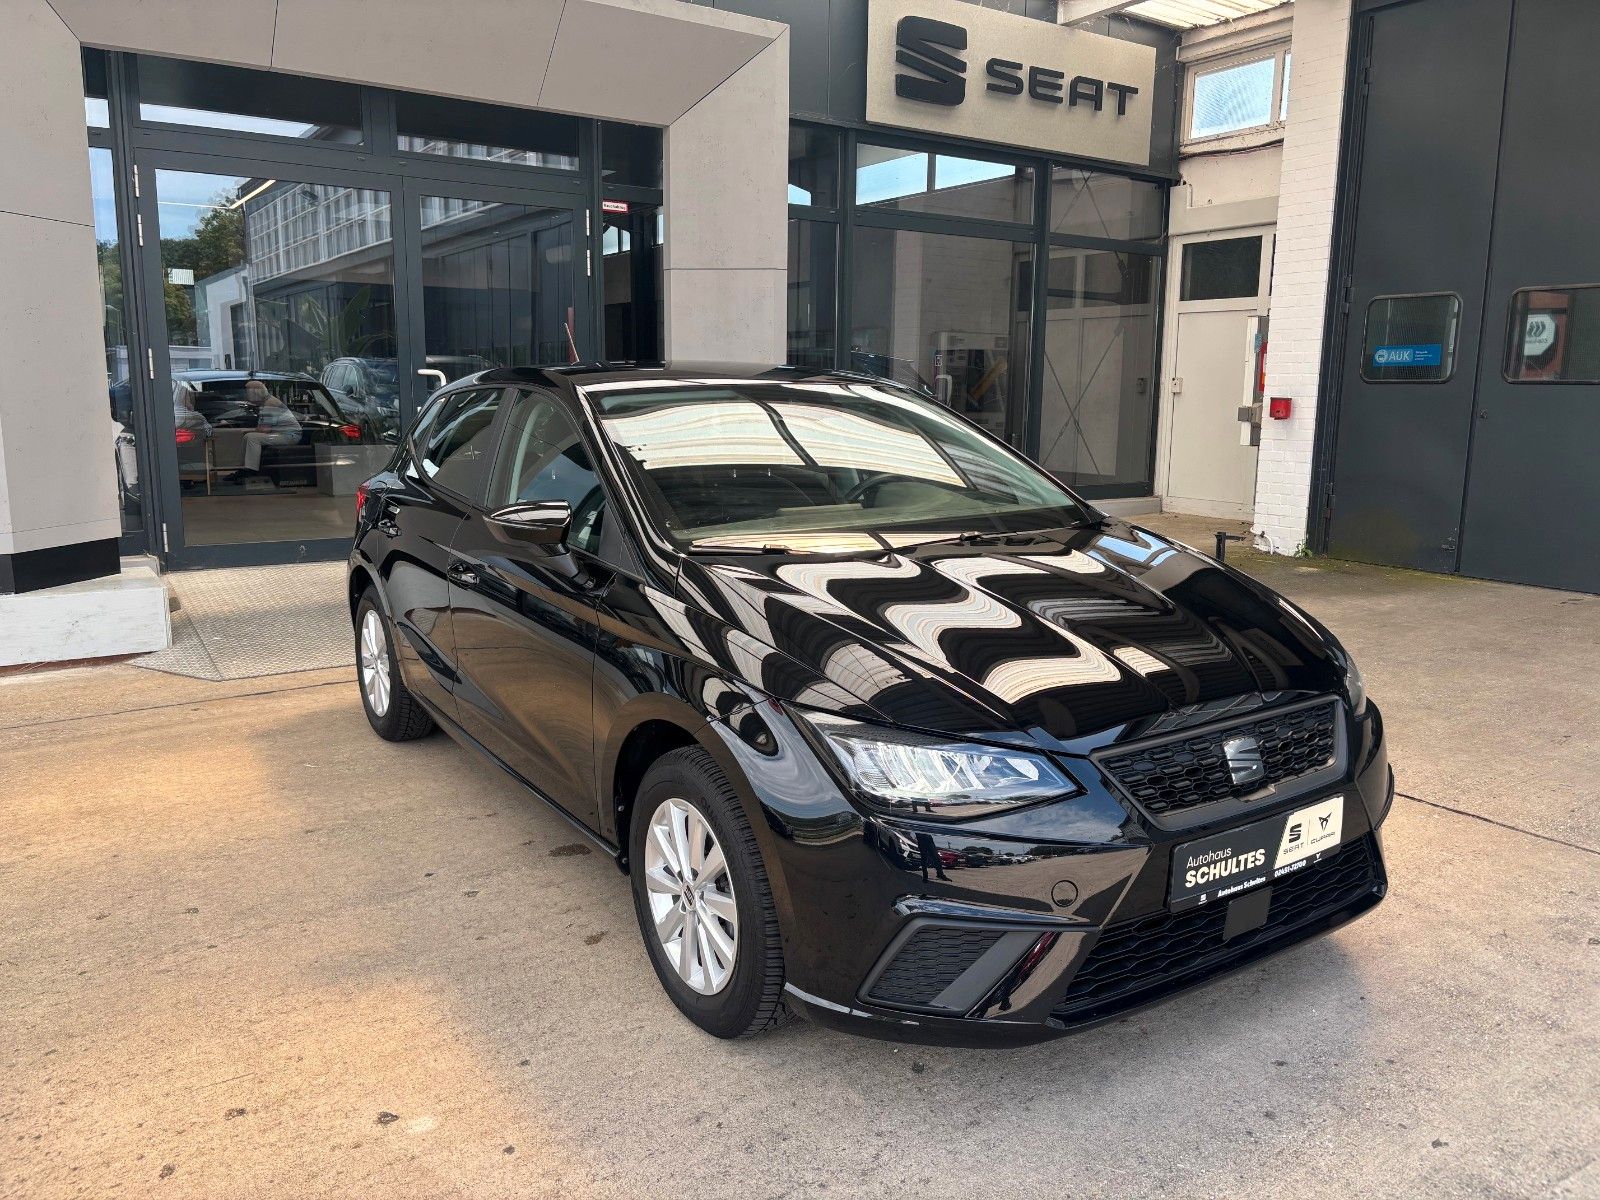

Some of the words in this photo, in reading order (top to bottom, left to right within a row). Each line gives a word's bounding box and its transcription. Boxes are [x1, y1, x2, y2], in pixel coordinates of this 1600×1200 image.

[985, 57, 1139, 116] SEAT
[1186, 847, 1232, 869] Autohaus
[1282, 842, 1305, 855] SEAT
[1185, 848, 1266, 888] SCHULTES
[1217, 884, 1243, 898] Autohaus
